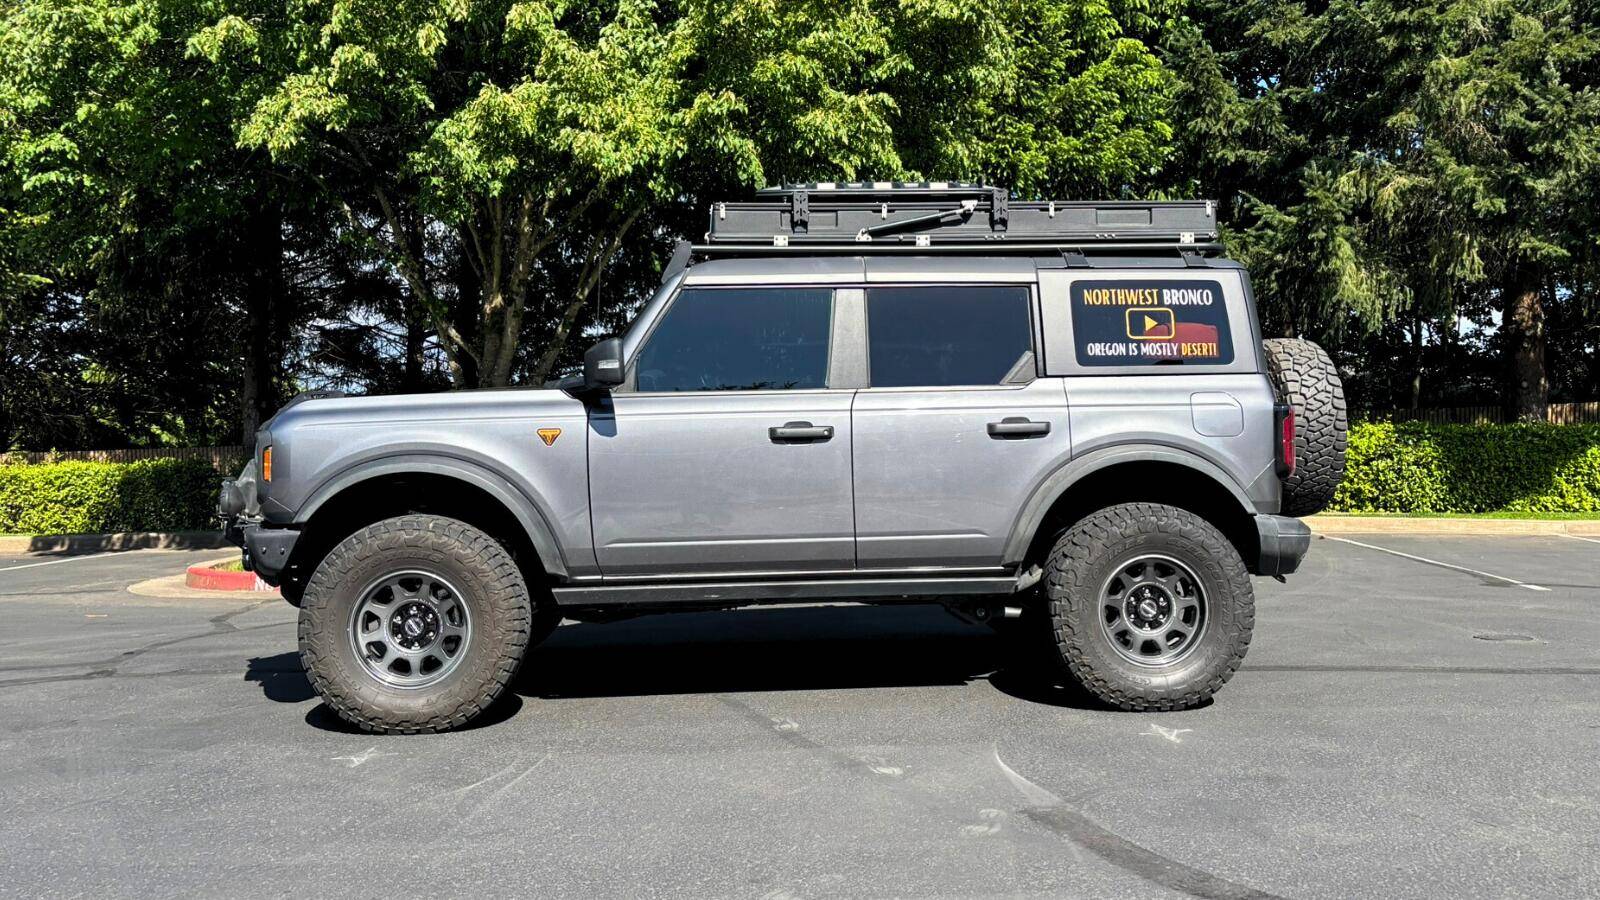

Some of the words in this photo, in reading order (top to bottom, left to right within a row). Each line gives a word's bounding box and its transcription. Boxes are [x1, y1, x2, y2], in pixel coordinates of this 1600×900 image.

[1083, 289, 1158, 306] NORTHWEST
[1163, 289, 1213, 305] BRONCO
[1087, 343, 1126, 356] OREGON
[1129, 343, 1138, 356] IS
[1140, 343, 1178, 356] MOSTLY
[1181, 343, 1217, 356] DESERT!
